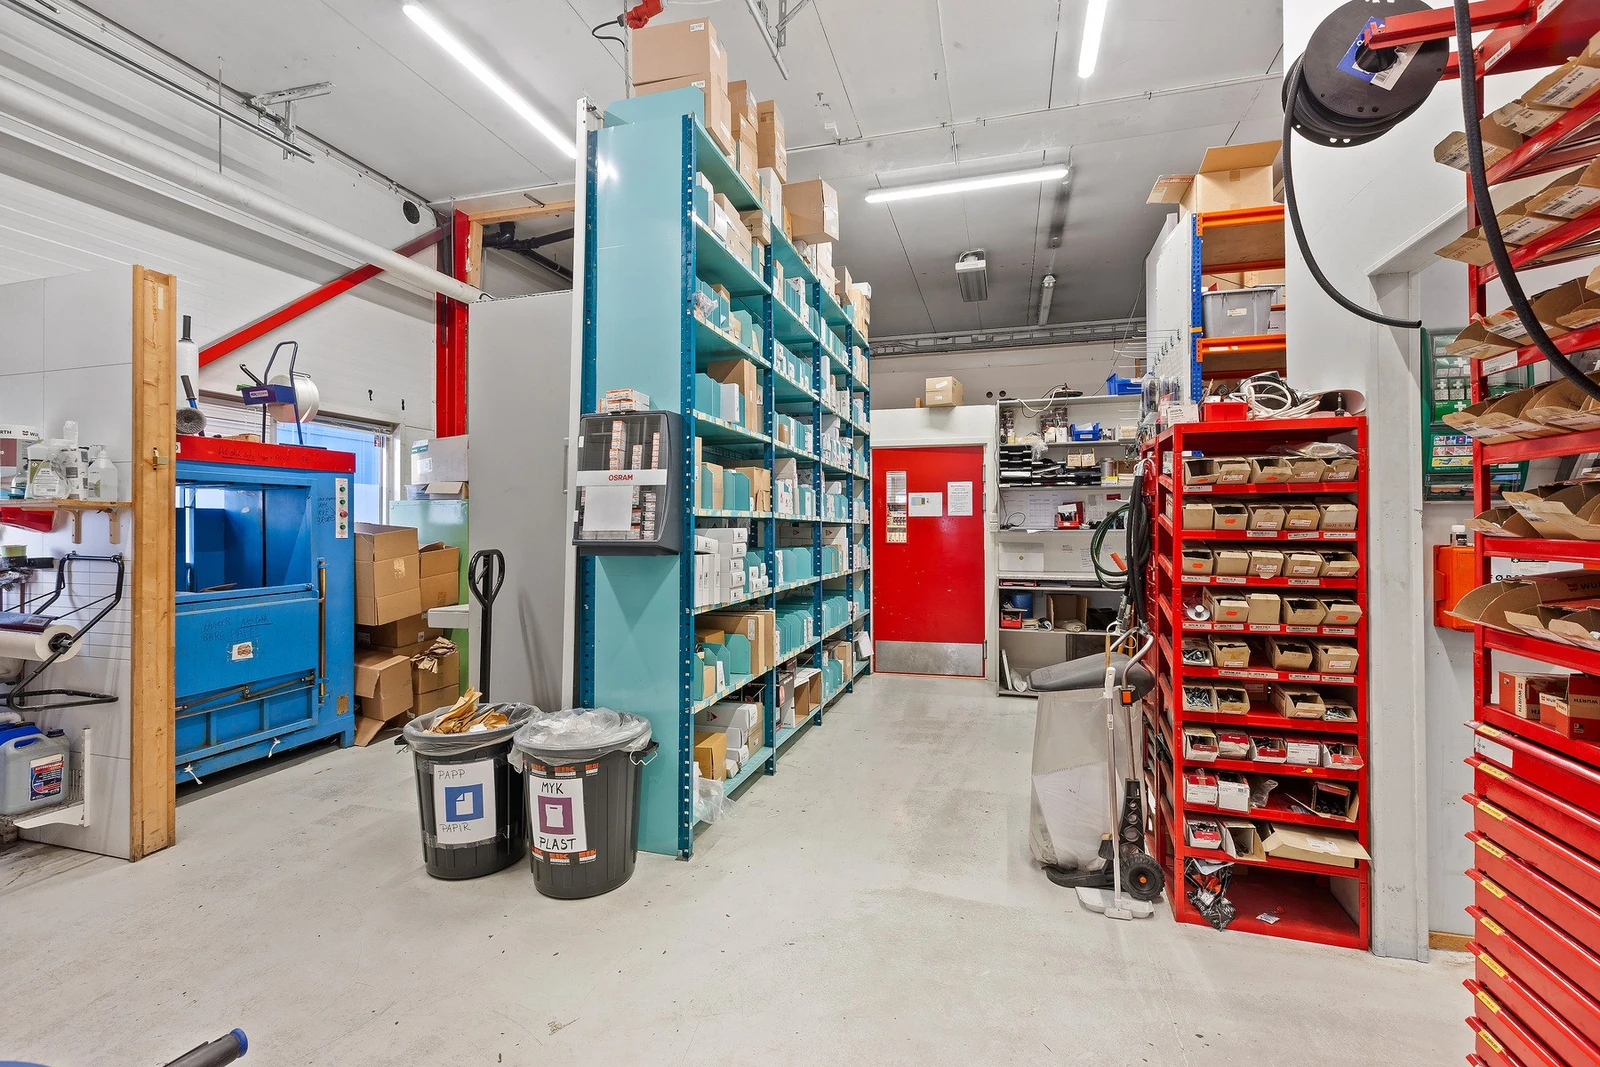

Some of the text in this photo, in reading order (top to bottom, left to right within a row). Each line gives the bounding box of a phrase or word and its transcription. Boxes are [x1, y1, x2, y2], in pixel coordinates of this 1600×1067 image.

[438, 769, 466, 780] PAPP
[541, 782, 564, 794] MYK
[439, 822, 472, 833] PAPIR
[539, 836, 576, 850] PLAST
